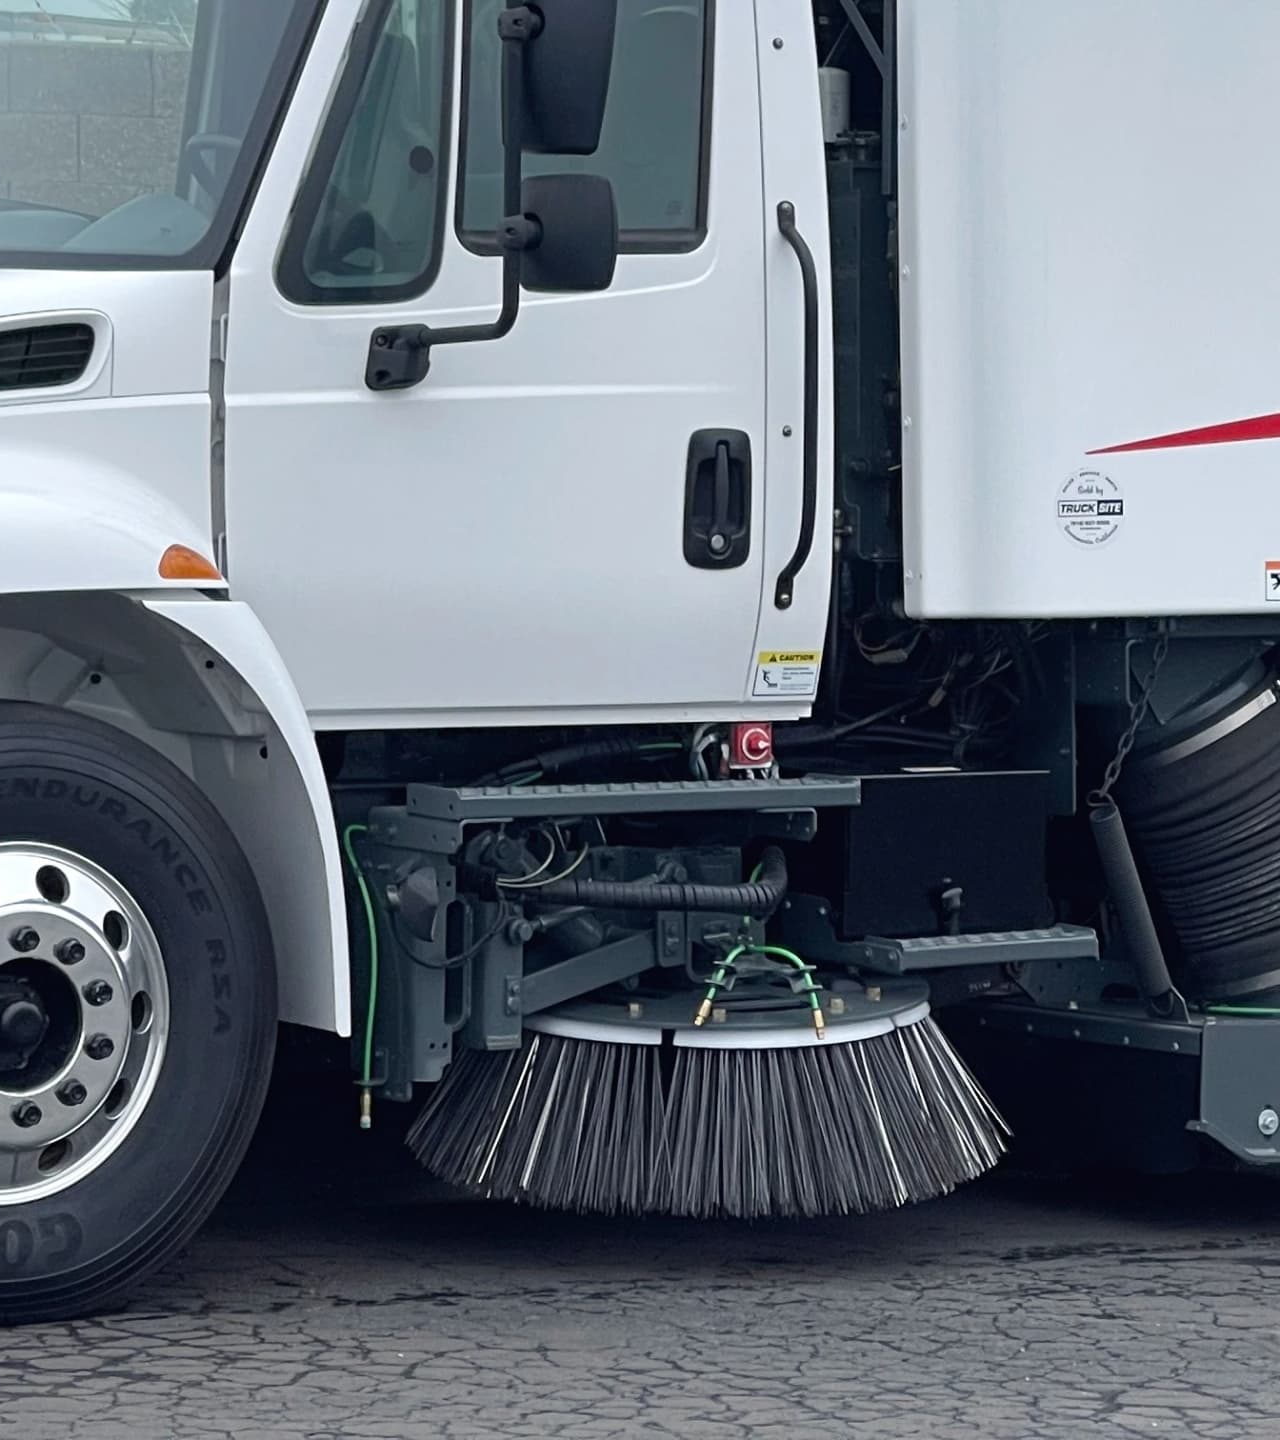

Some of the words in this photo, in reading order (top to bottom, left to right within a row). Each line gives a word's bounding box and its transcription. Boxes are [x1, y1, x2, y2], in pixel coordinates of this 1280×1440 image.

[1095, 485, 1104, 497] by
[1060, 503, 1096, 514] TRUCK
[1098, 502, 1122, 513] SITE
[779, 654, 814, 662] CAUTION
[204, 937, 233, 1035] RSA
